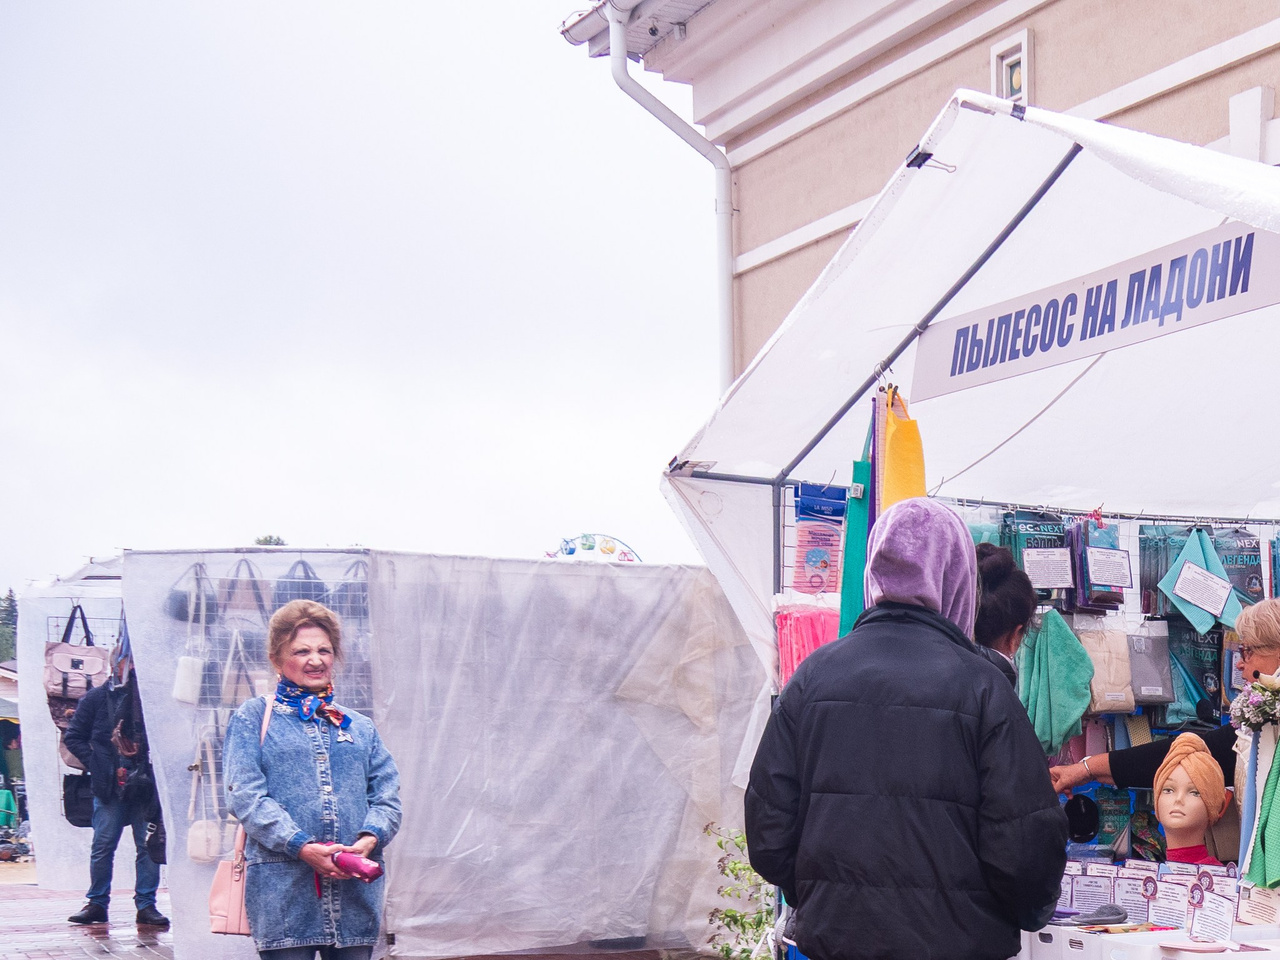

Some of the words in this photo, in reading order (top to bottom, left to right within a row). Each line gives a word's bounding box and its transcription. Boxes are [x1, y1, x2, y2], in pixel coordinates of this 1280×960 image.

[950, 292, 1078, 378] ПЫЛЕСОС
[1080, 278, 1119, 342] НА
[1120, 232, 1255, 328] ЛАДОНИ
